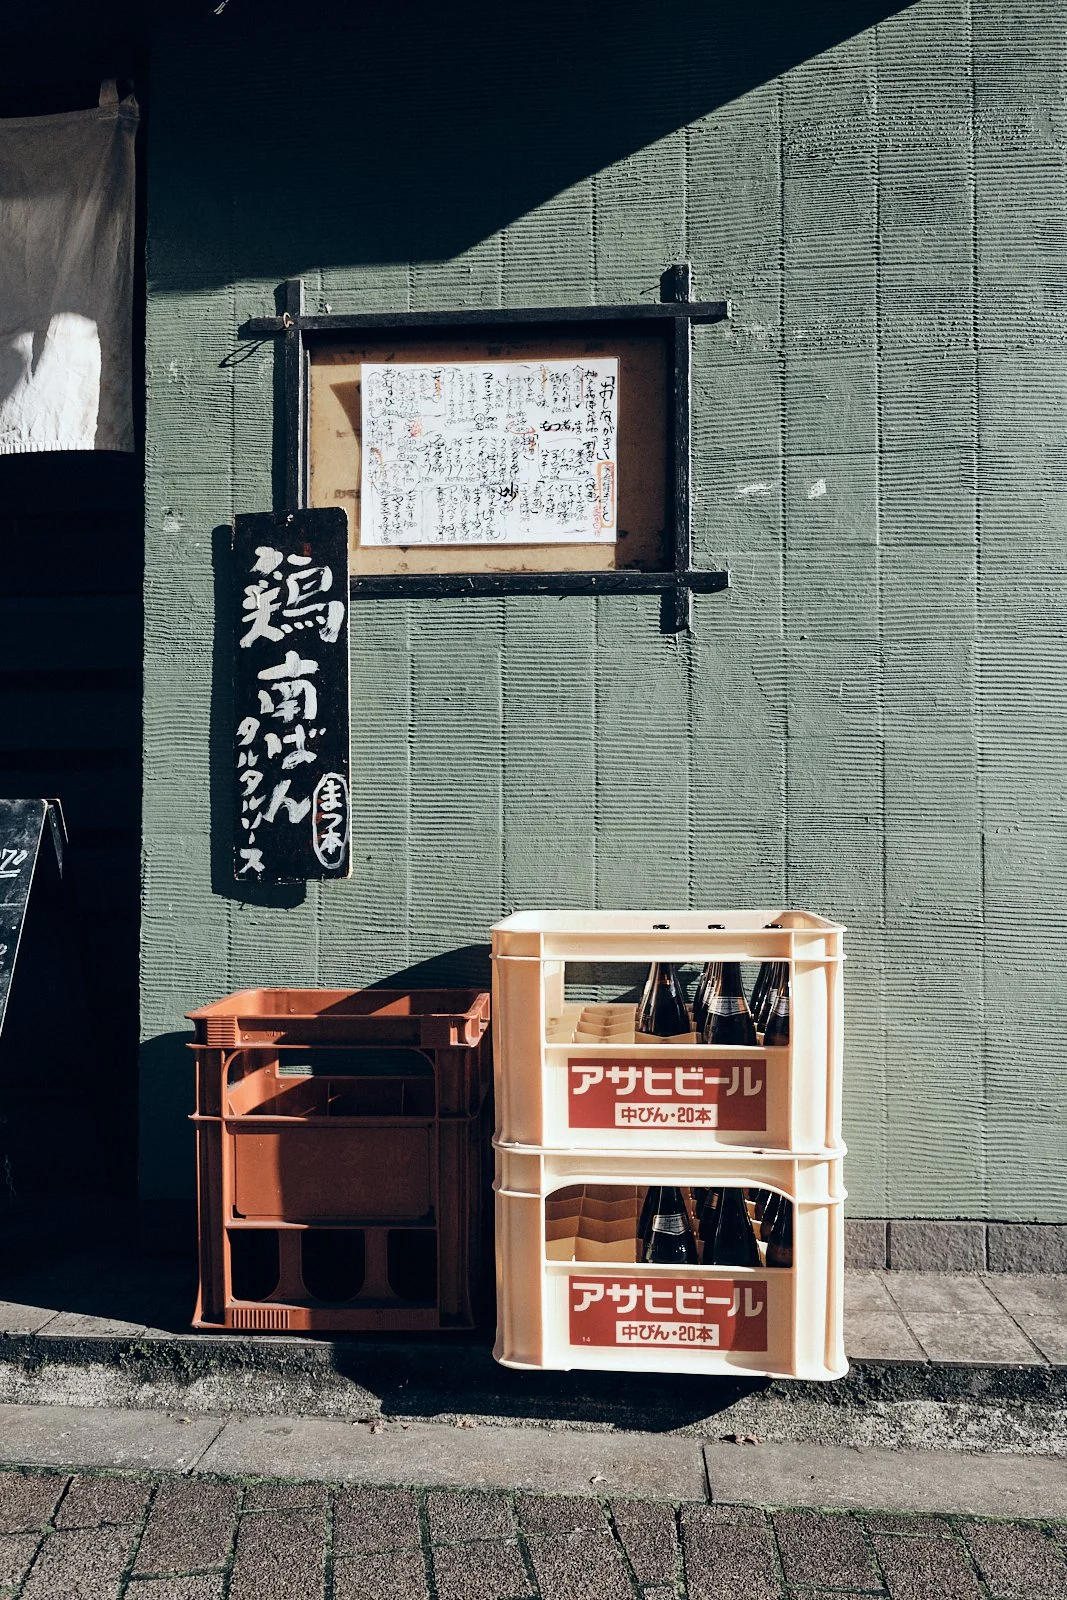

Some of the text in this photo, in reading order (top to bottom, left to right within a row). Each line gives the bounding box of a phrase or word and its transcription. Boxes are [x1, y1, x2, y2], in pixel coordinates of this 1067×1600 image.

[240, 546, 345, 824] 鶏南ばん
[236, 717, 266, 873] タルタルソース
[319, 780, 343, 854] まつ本
[571, 1066, 763, 1097] アサヒビール
[620, 1106, 712, 1124] 中びん・20本
[572, 1282, 764, 1317] アサヒビール
[621, 1323, 713, 1343] 中びん・20本
